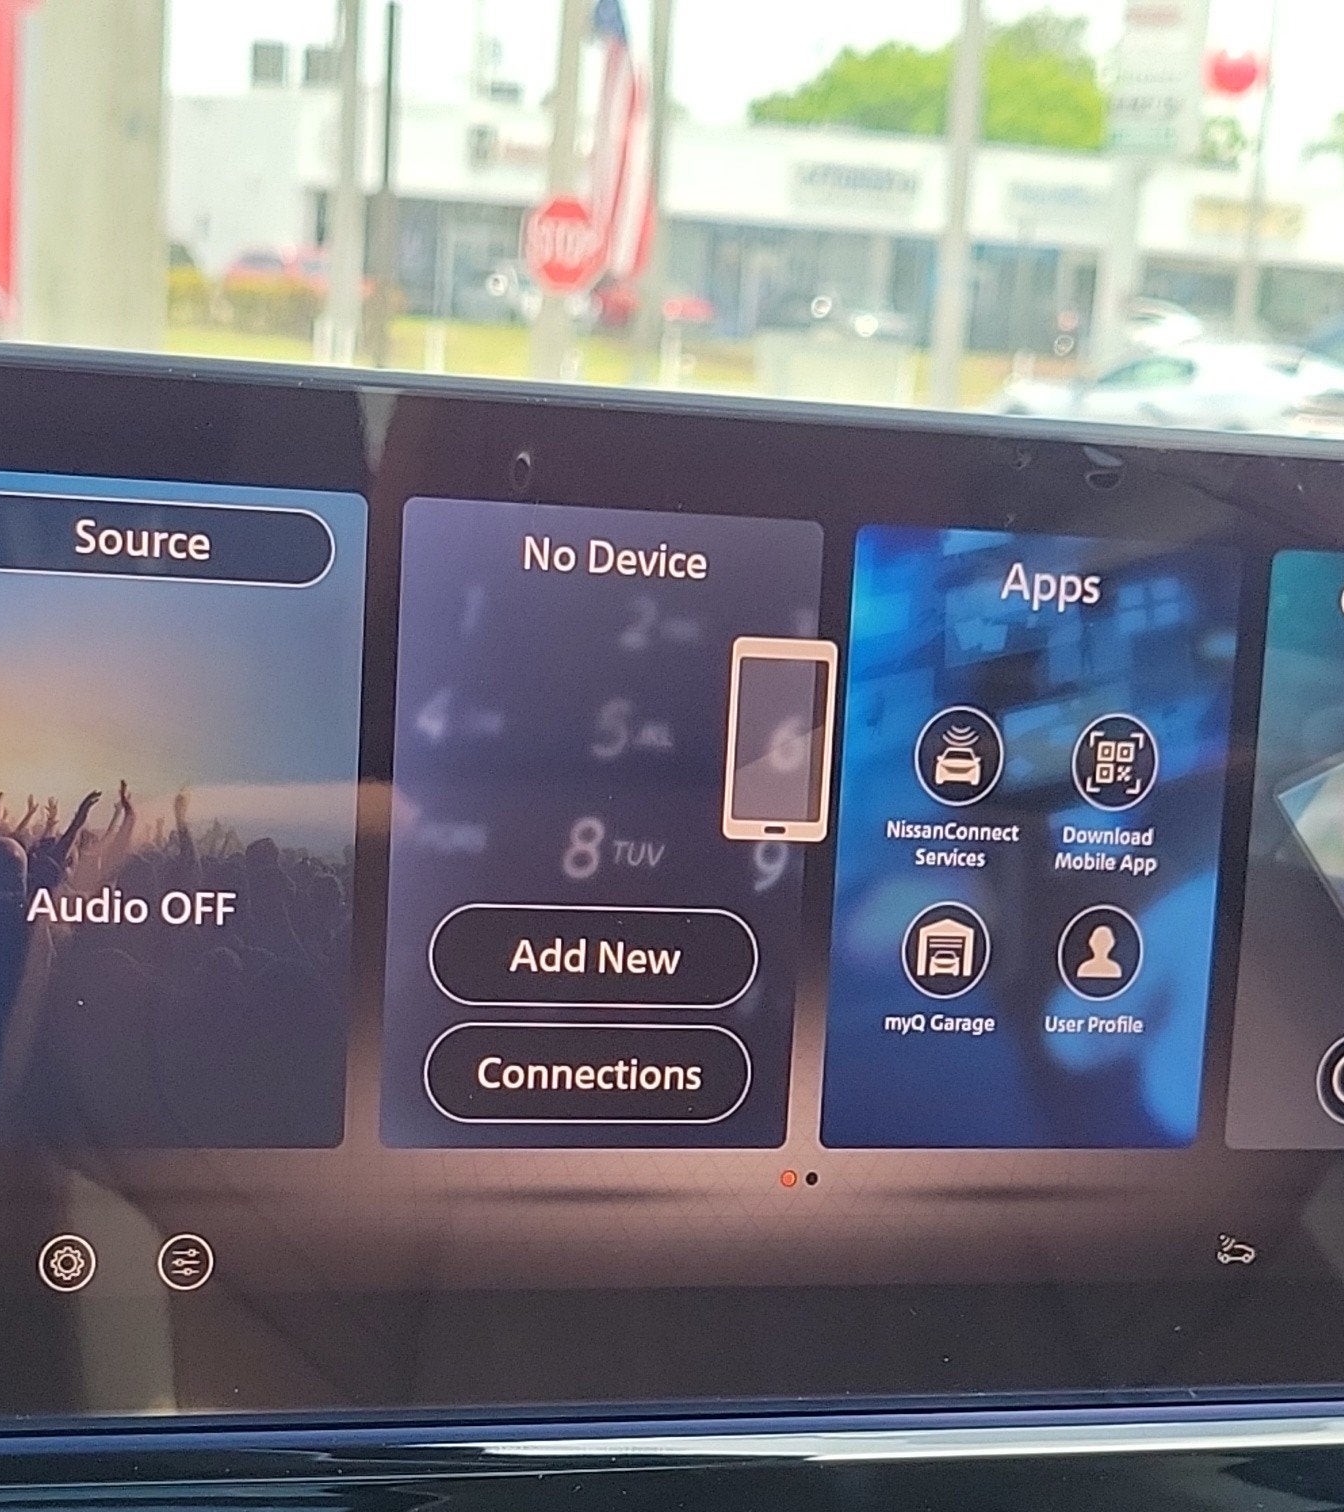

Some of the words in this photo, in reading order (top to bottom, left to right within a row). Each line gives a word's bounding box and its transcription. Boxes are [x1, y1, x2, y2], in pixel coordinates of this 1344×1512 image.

[75, 518, 211, 561] Source
[523, 536, 576, 574] No
[588, 539, 708, 579] Device
[1001, 562, 1101, 612] Apps
[563, 816, 605, 879] 8
[613, 839, 666, 868] TUV
[886, 820, 1020, 843] NissanConnect
[1063, 826, 1154, 847] Download
[914, 847, 986, 868] Services
[1055, 852, 1116, 872] Mobile
[1120, 854, 1157, 877] App
[27, 887, 148, 925] Audio
[160, 891, 236, 926] OFF
[509, 938, 586, 973] Add
[598, 941, 681, 975] New
[885, 1014, 926, 1034] myQ
[930, 1014, 995, 1036] Garage
[1045, 1016, 1084, 1034] User
[1088, 1016, 1143, 1034] Profile
[477, 1057, 702, 1090] Connections
